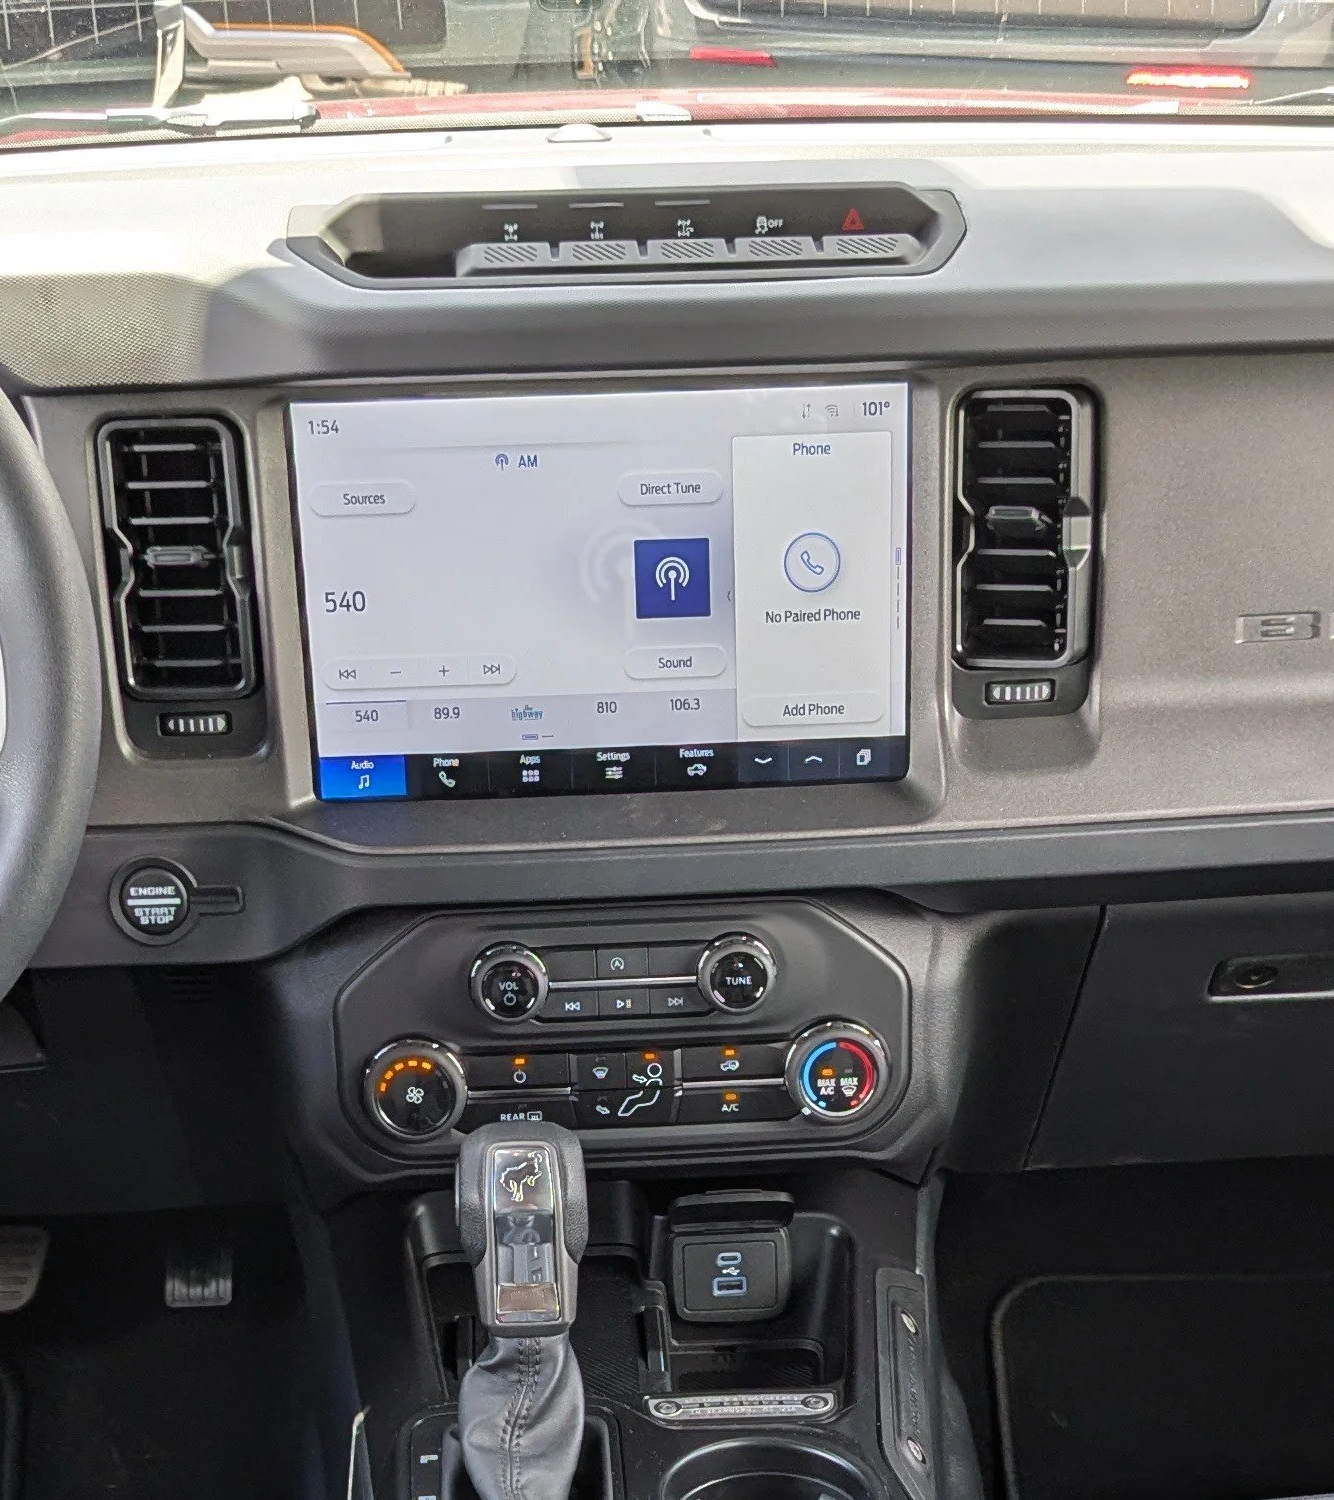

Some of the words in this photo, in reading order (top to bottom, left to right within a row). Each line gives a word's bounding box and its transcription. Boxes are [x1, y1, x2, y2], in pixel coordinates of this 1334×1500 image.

[767, 219, 784, 228] OFF
[308, 420, 340, 435] 1:54
[793, 442, 831, 456] Phone
[518, 455, 538, 468] AM
[640, 483, 672, 496] Direct
[673, 482, 701, 495] Tune
[343, 493, 385, 505] Sources
[324, 591, 367, 613] 540
[765, 611, 782, 623] No
[784, 610, 821, 622] Paired
[824, 609, 861, 621] Phone
[658, 656, 692, 669] Sound
[597, 701, 617, 714] 810
[670, 698, 701, 711] 106.3
[783, 704, 806, 717] Add
[808, 703, 845, 716] Phone
[355, 710, 379, 723] 540
[434, 707, 460, 720] 89.9
[596, 751, 630, 762] Settings
[679, 748, 714, 759] Features
[433, 757, 459, 768] Phone
[519, 754, 541, 765] Apps
[351, 761, 374, 770] Audio
[129, 886, 176, 897] ENGINE
[134, 907, 176, 917] START
[140, 916, 174, 925] STOP
[498, 981, 519, 991] VOL
[725, 976, 752, 986] TUNE
[817, 1078, 836, 1087] MAX
[840, 1077, 858, 1086] MAX
[721, 1104, 739, 1112] A/C
[500, 1113, 525, 1121] REAR
[420, 1455, 438, 1463] P
